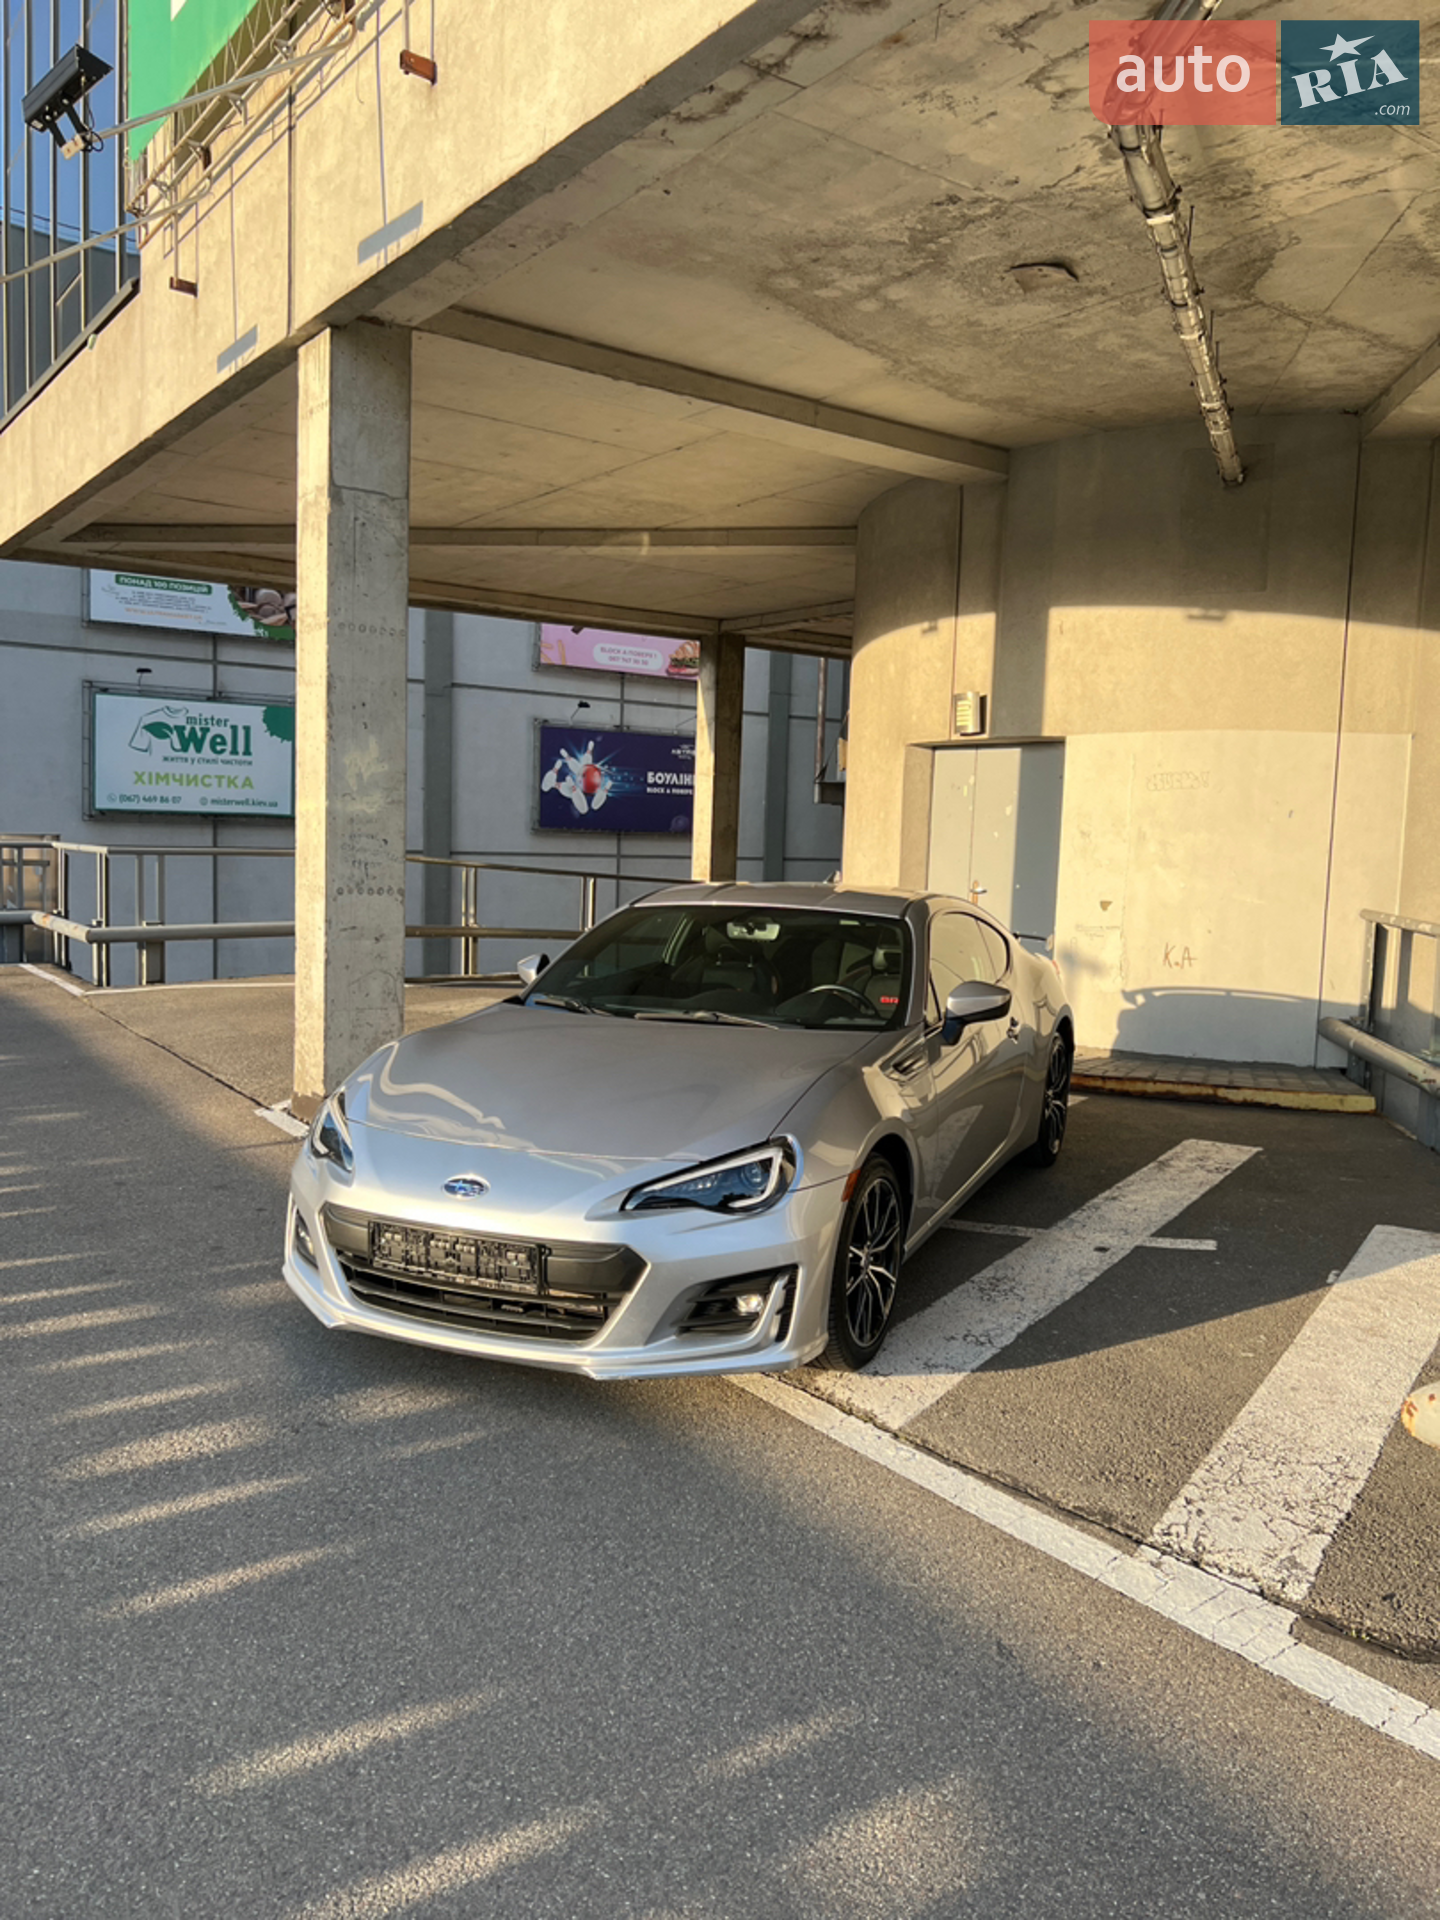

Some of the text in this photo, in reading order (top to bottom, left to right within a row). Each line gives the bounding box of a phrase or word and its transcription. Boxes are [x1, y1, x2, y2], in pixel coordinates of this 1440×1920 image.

[185, 713, 230, 728] mister
[172, 724, 253, 757] Well
[133, 770, 255, 790] ХІМЧИСТКА
[646, 770, 695, 786] БОУЛІН
